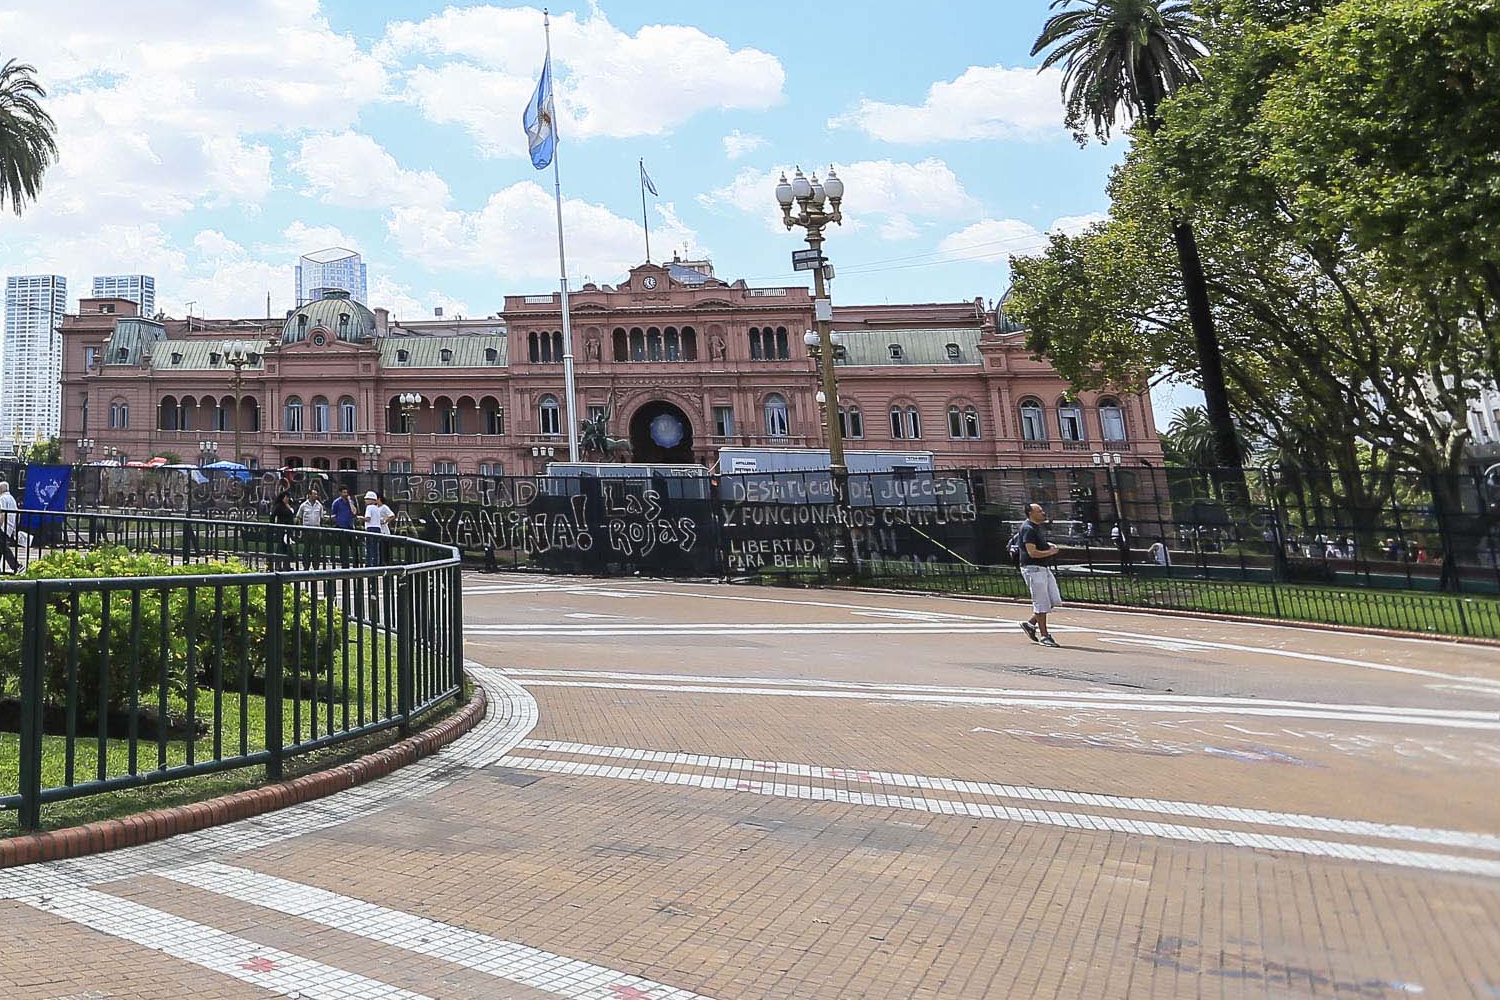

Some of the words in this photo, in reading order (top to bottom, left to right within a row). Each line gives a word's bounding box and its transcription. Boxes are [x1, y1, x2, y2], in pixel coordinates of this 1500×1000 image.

[851, 481, 872, 498] DE
[881, 479, 956, 499] JUECES
[722, 508, 737, 526] Y
[742, 505, 876, 527] FUNCIONARIOS
[730, 538, 815, 553] LIBERTAD
[728, 553, 765, 568] PARA
